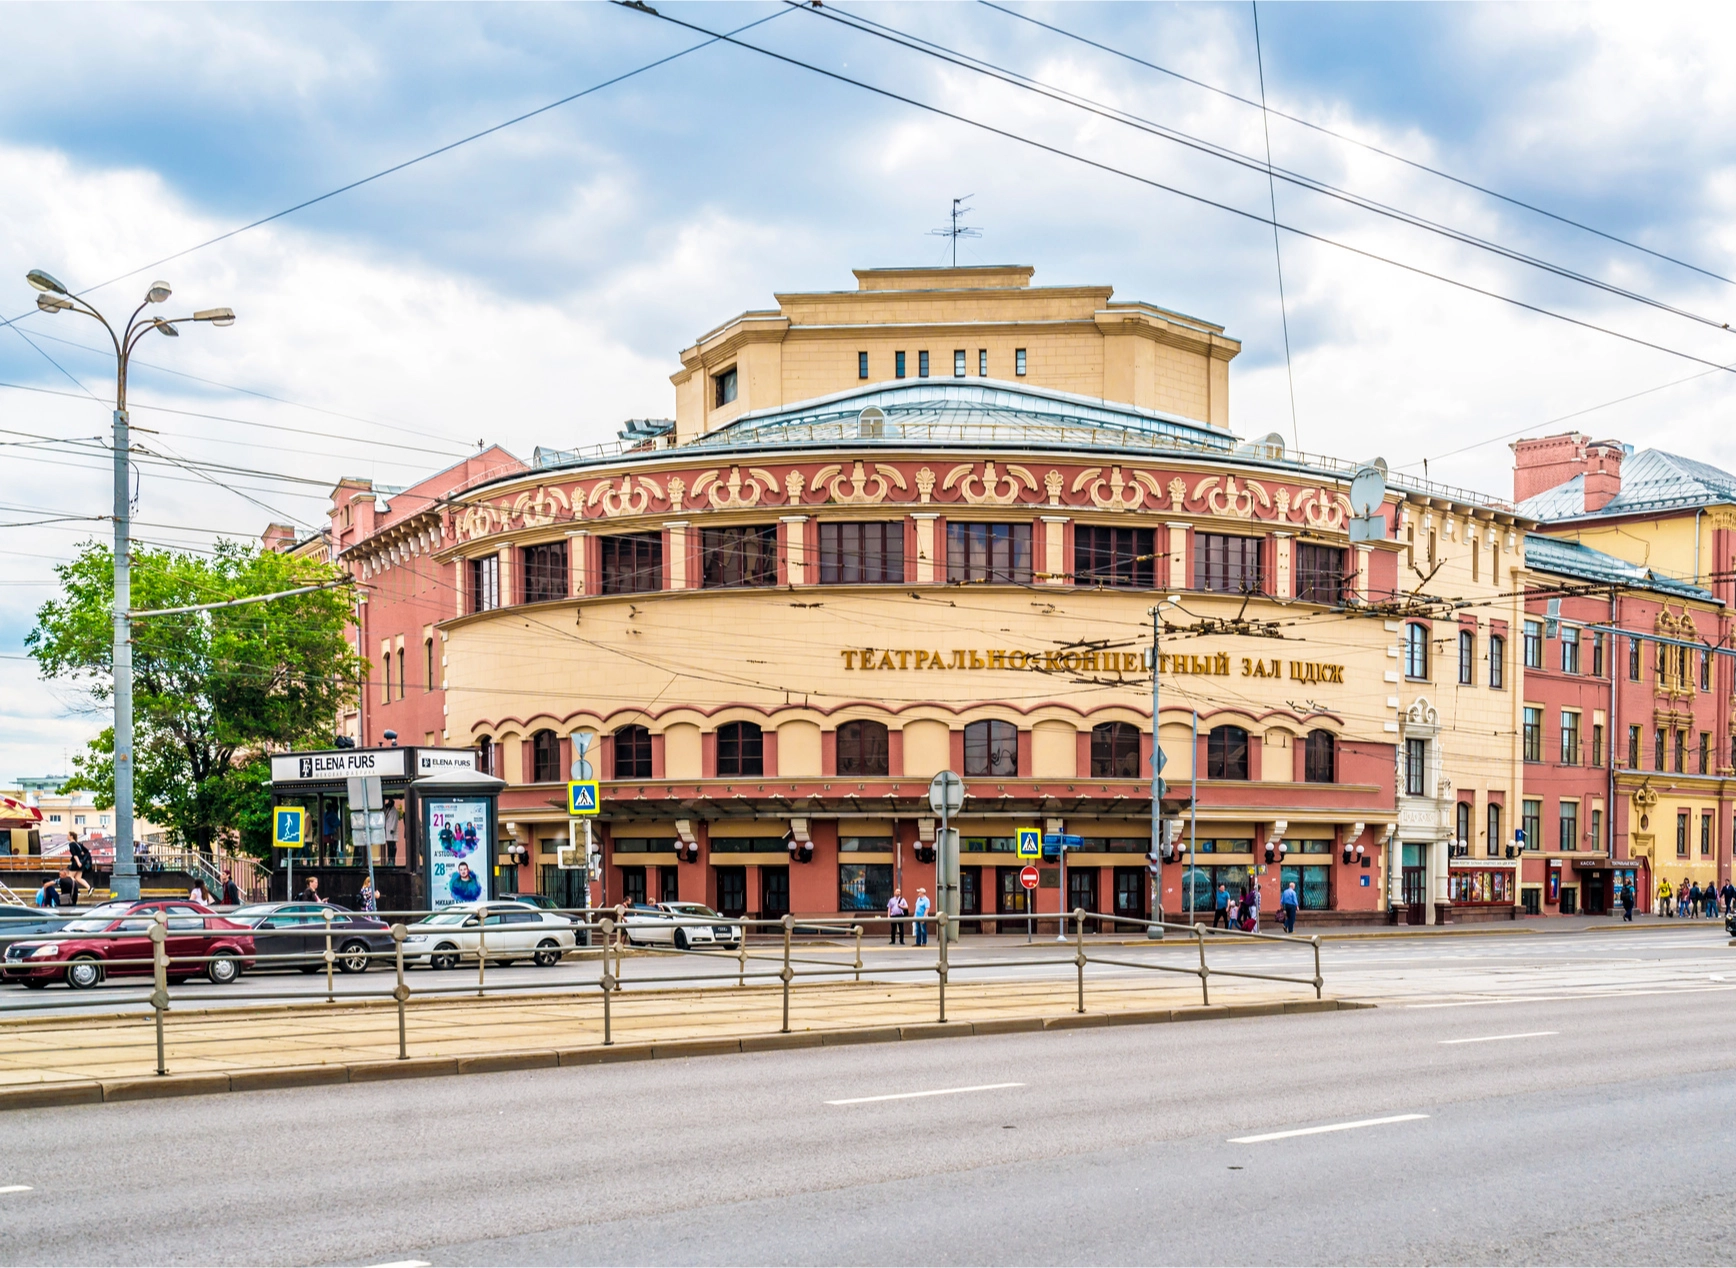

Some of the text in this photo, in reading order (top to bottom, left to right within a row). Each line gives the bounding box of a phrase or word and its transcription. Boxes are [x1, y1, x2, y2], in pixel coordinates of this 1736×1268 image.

[1241, 657, 1282, 678] ЗАЛ
[1290, 660, 1345, 685] ЦДКЖ
[315, 756, 345, 771] ELENA
[348, 754, 375, 769] FURS
[432, 758, 453, 766] ELENA
[454, 759, 471, 767] FURS
[433, 813, 444, 827] 21
[434, 862, 446, 876] 28
